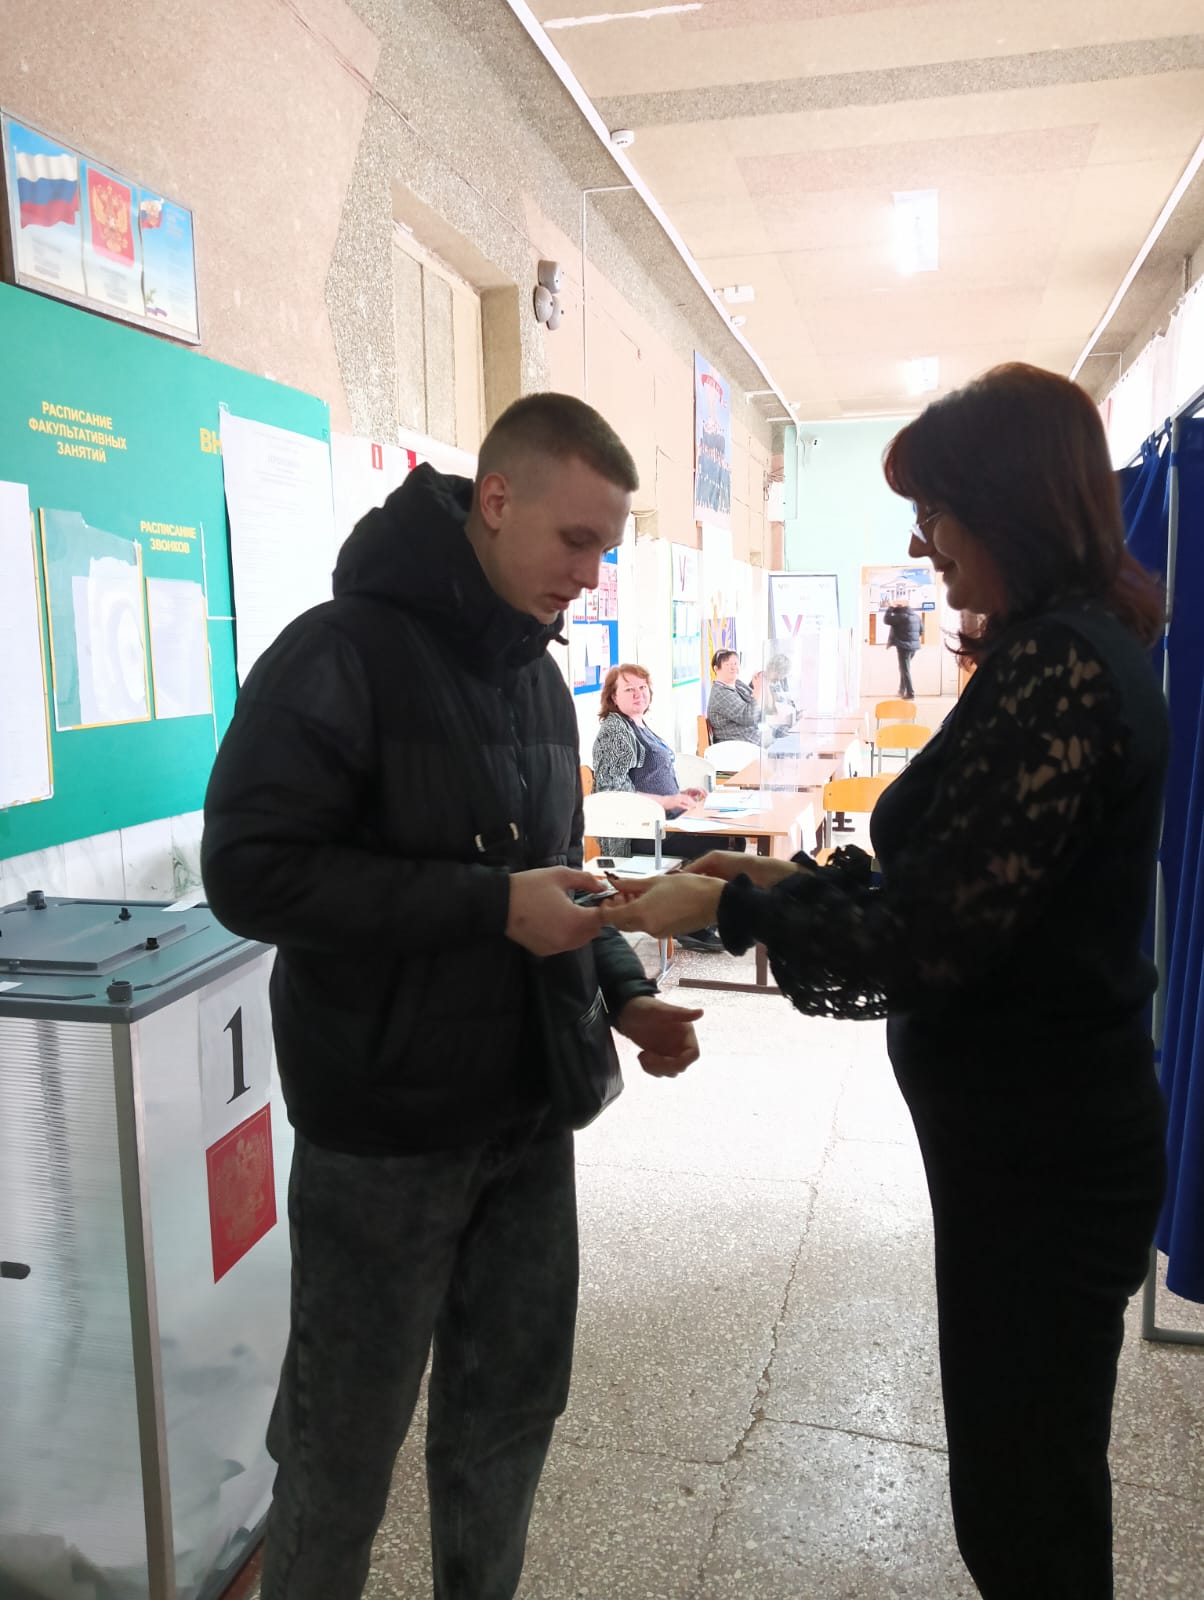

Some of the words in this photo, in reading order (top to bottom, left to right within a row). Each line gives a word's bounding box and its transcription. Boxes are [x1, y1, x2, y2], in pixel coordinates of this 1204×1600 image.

[41, 401, 113, 430] РАСПИСАНИЕ
[28, 417, 127, 450] ФАКУЛЬТАТИВНЫХ
[57, 441, 107, 463] ЗАНЯТИЙ
[140, 520, 196, 539] РАСПИСАНИЕ
[150, 538, 190, 553] ЗВОНКОВ
[223, 1005, 251, 1105] 1
